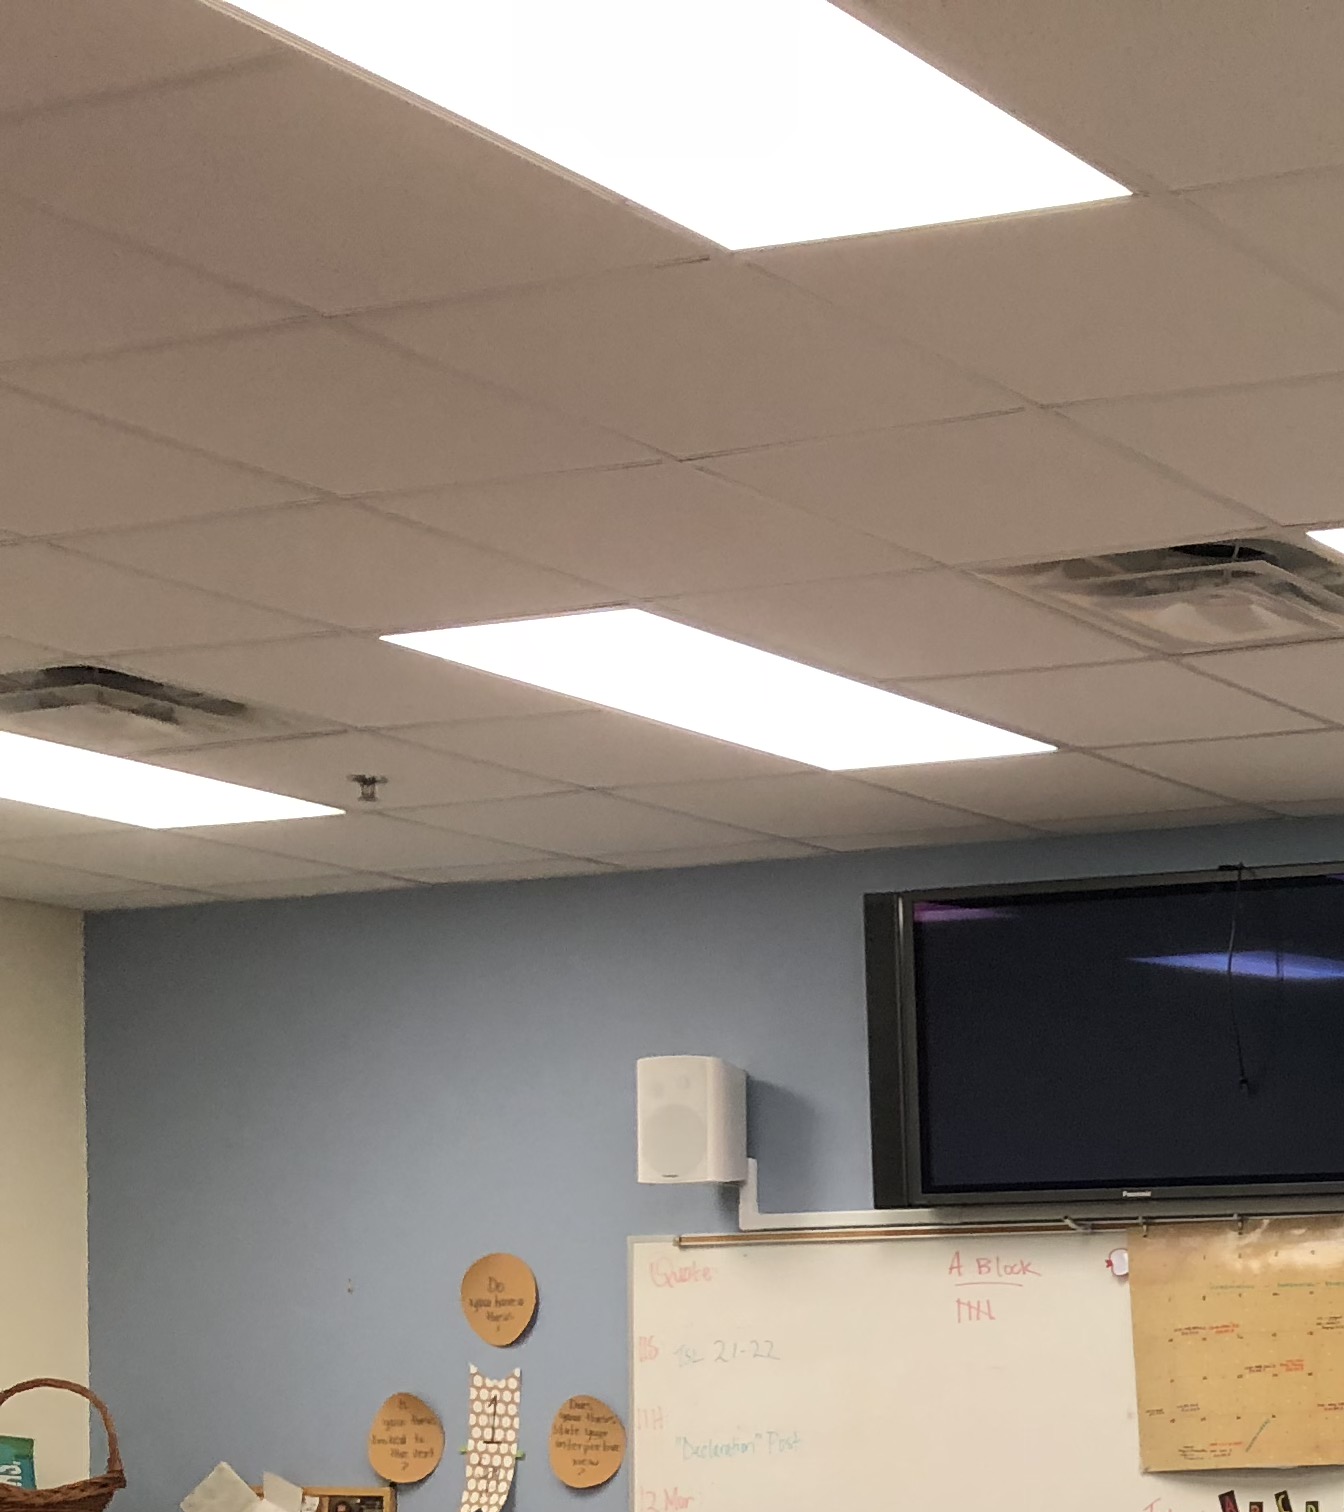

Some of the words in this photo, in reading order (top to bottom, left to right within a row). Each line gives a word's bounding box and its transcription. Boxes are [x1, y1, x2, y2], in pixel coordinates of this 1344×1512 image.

[948, 1250, 963, 1277] A
[976, 1256, 1042, 1278] Block
[713, 1340, 781, 1363] 21-22
